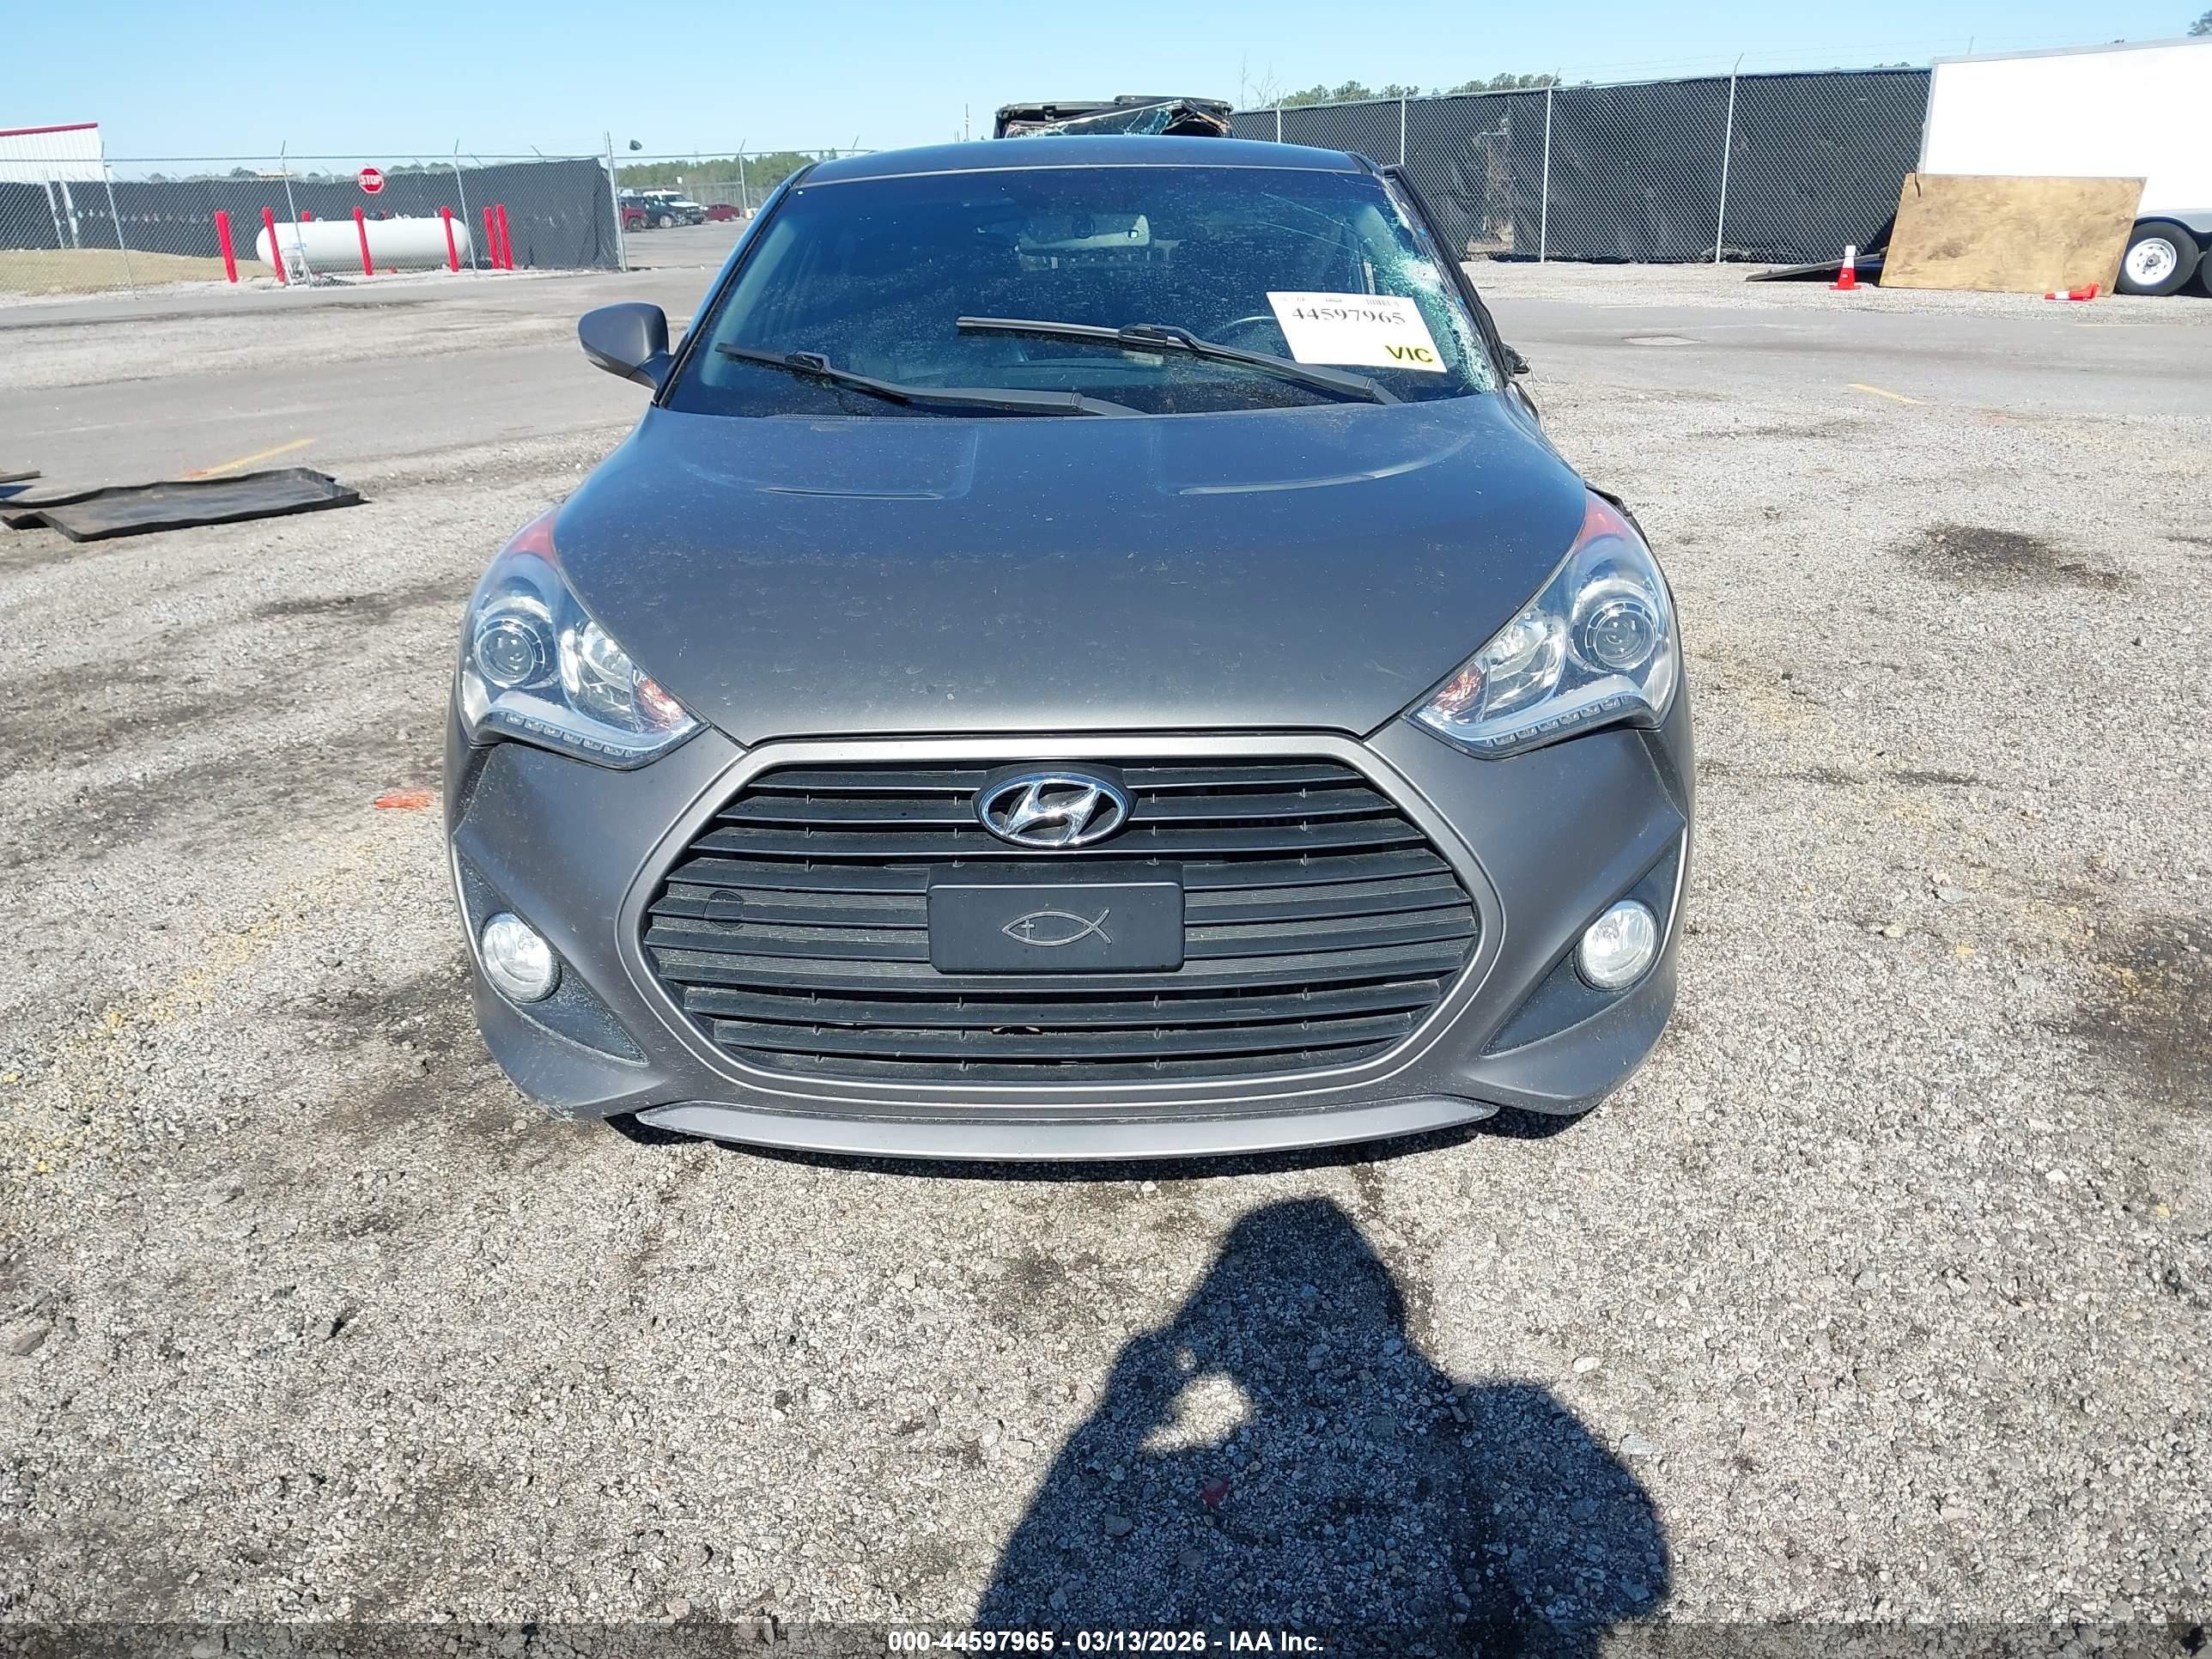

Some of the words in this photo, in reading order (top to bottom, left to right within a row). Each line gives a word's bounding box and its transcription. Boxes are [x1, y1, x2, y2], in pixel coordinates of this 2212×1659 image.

[361, 174, 382, 185] STOP
[1291, 307, 1406, 325] 44597965
[1385, 344, 1433, 363] VIC
